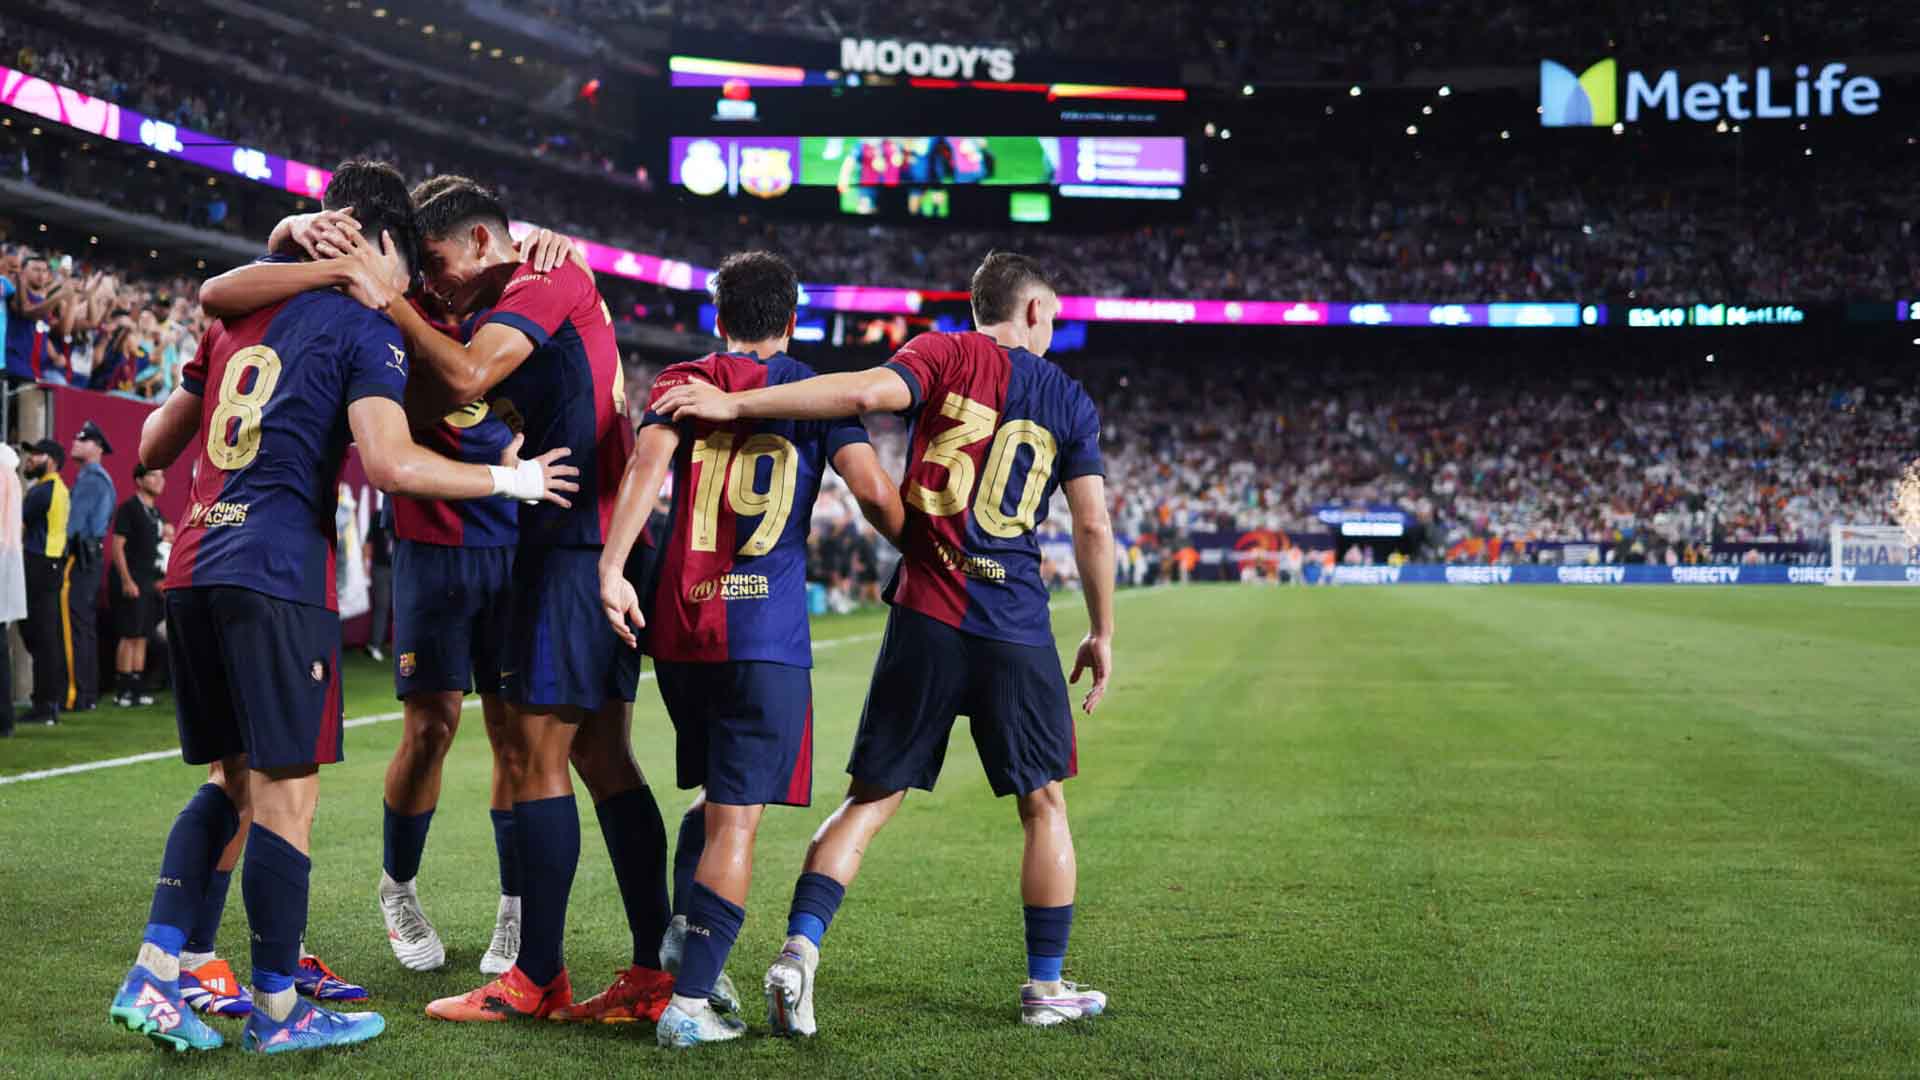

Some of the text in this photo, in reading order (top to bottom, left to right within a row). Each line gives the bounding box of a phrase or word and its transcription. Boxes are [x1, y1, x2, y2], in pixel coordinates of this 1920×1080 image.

[840, 37, 1015, 81] MOODY'S
[1625, 62, 1881, 122] MetLife
[1726, 305, 1804, 327] MetLife
[206, 344, 283, 470] 8
[904, 391, 1058, 539] 30
[691, 430, 799, 557] 19
[720, 574, 768, 585] UNHCR
[720, 584, 769, 595] ACNUR
[1557, 565, 1625, 583] DIRECTV
[1672, 565, 1739, 583] DIRECTV
